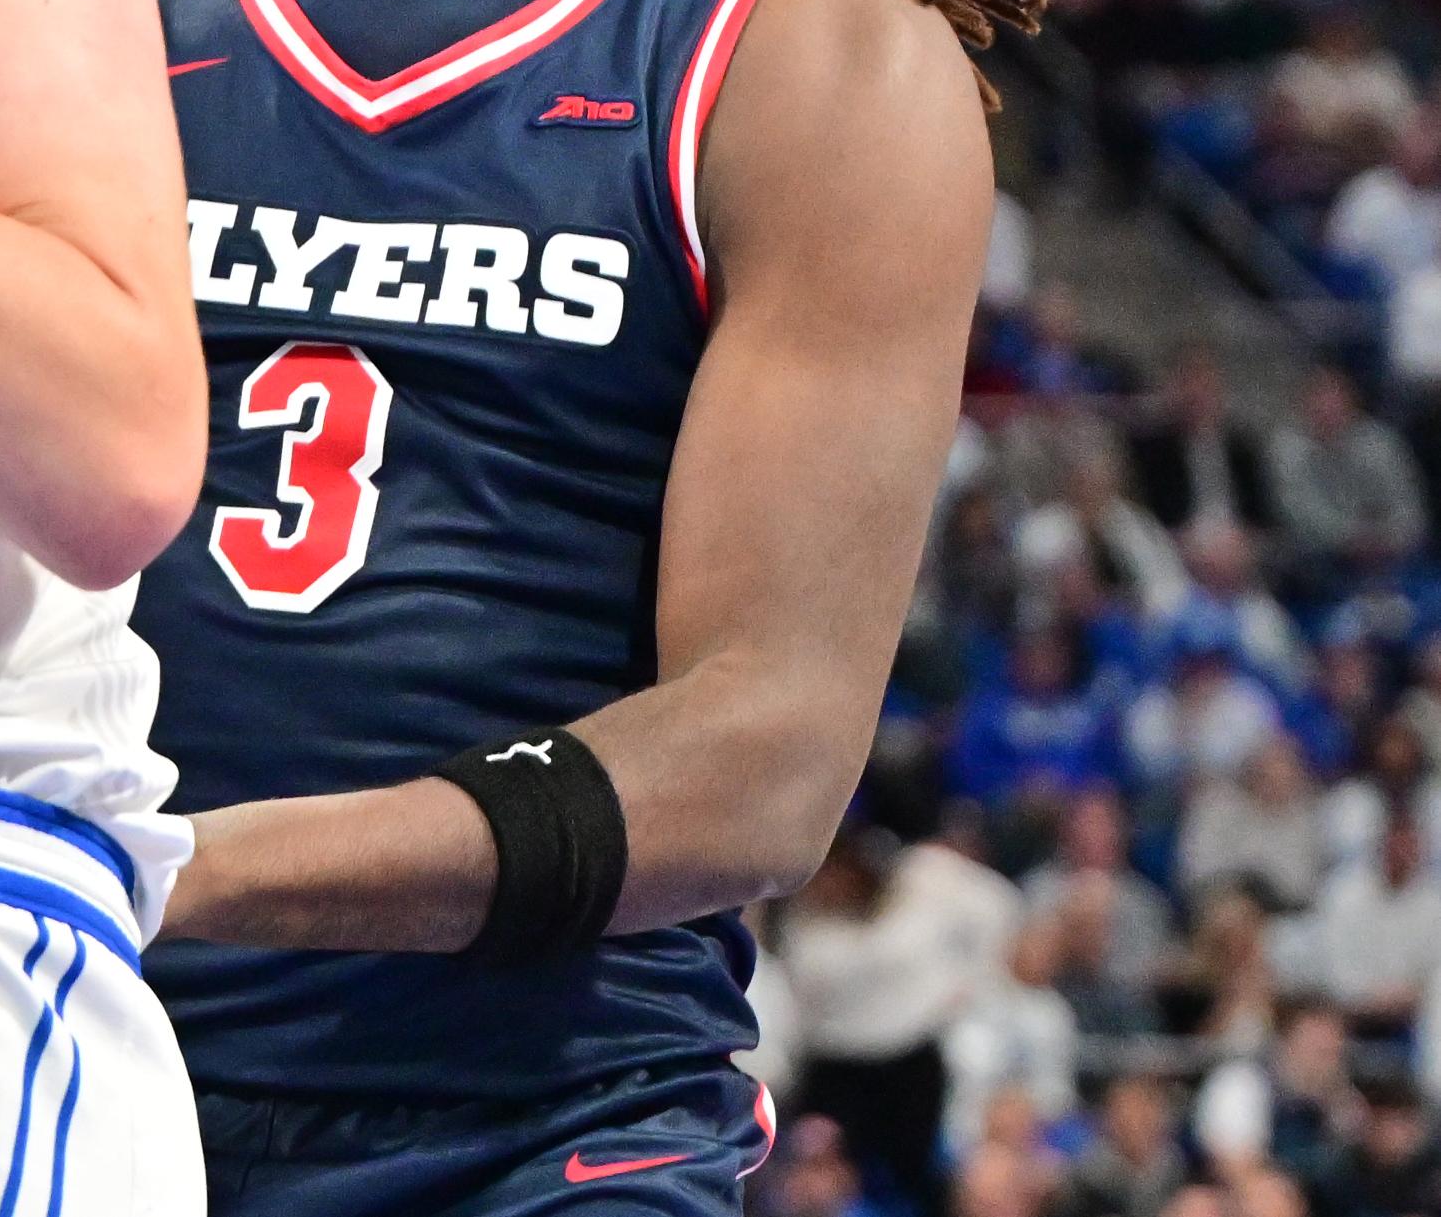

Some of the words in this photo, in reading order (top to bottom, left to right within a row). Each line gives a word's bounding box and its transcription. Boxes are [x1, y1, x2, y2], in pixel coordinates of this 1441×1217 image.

[538, 95, 635, 121] A10
[186, 199, 630, 346] LYERS
[209, 340, 394, 613] 3
